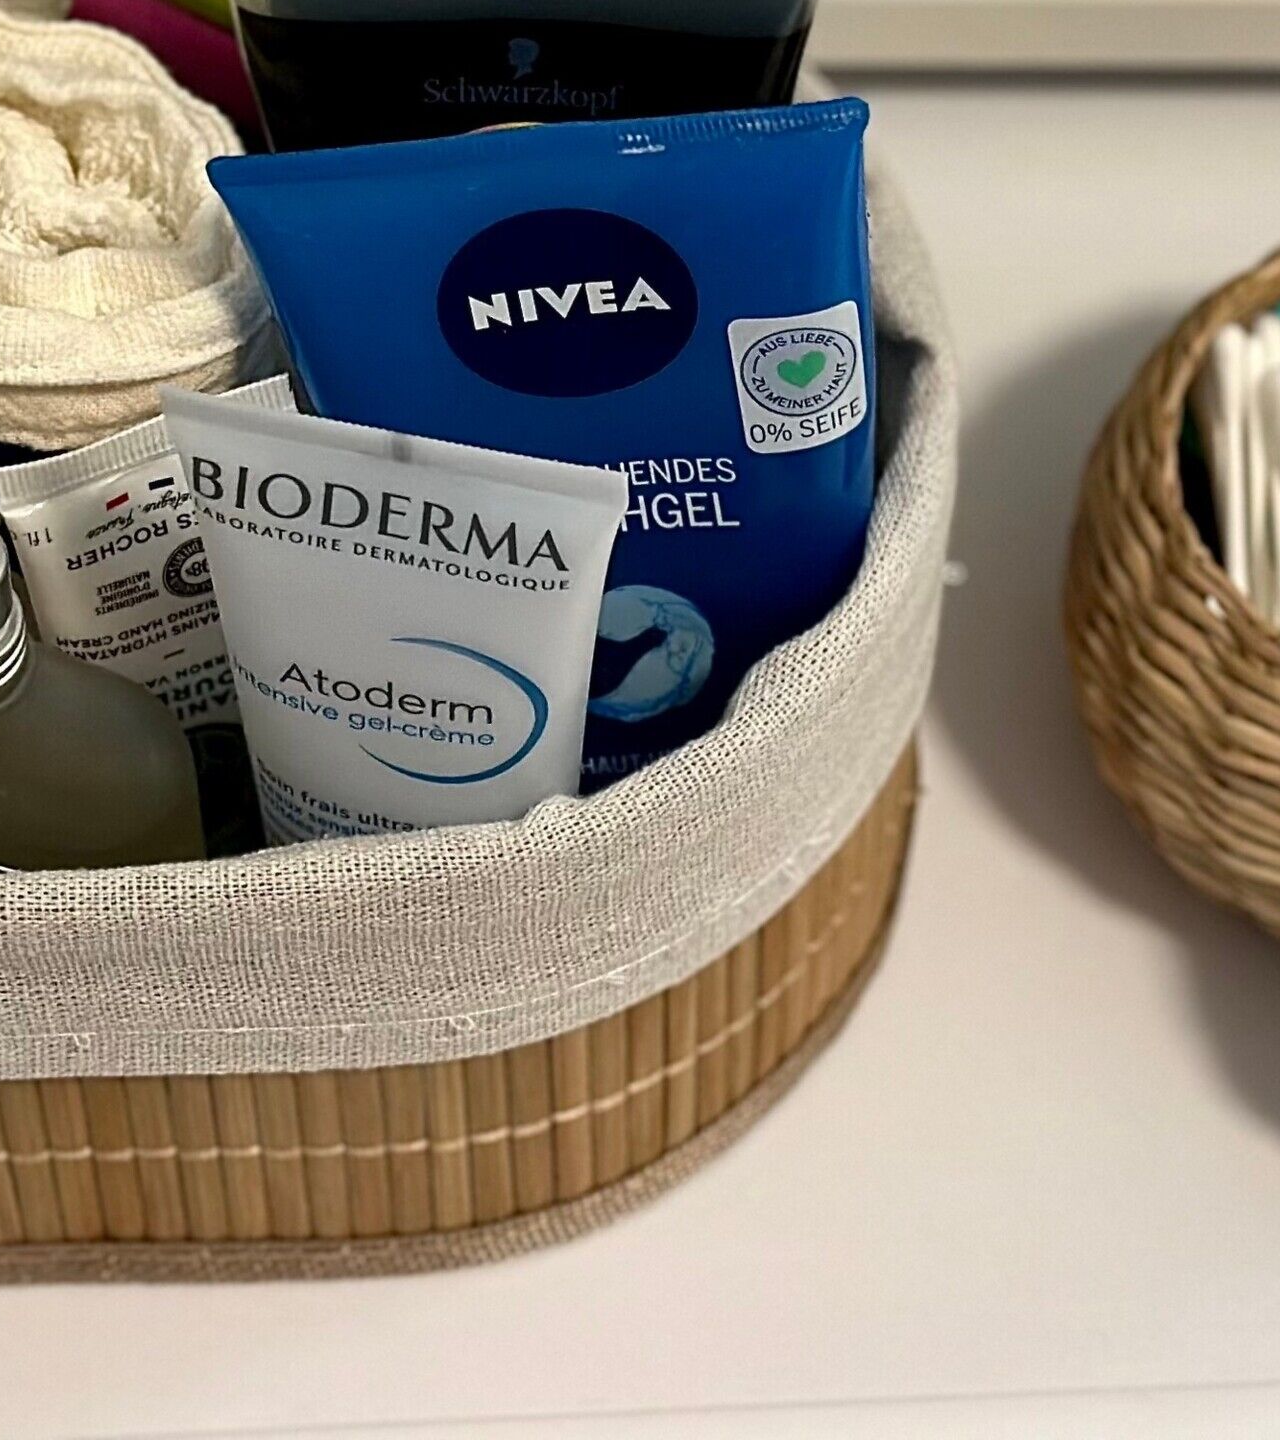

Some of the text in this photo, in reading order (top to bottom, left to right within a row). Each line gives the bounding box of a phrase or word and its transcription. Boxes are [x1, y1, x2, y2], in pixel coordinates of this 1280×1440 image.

[423, 76, 624, 116] Schwarzkopf
[468, 276, 672, 332] NIVEA
[758, 332, 834, 358] AUS LIEBE
[751, 362, 848, 409] ZU MEINER HAUT
[749, 396, 862, 444] 0% SEIFE
[604, 457, 738, 486] ENDES
[84, 507, 135, 540] France
[192, 456, 570, 572] BIODERMA
[45, 527, 53, 544] 1
[65, 519, 169, 572] ROCHER
[194, 497, 570, 592] LABORATOIRE DERMATOLOGIQUE
[55, 633, 114, 649] CREAM
[65, 629, 167, 661] HYDRATAN
[117, 619, 163, 641] HAND
[175, 654, 230, 680] RBON
[279, 662, 493, 725] Atoderm
[348, 712, 495, 746] gel-crème
[301, 789, 351, 820] frais
